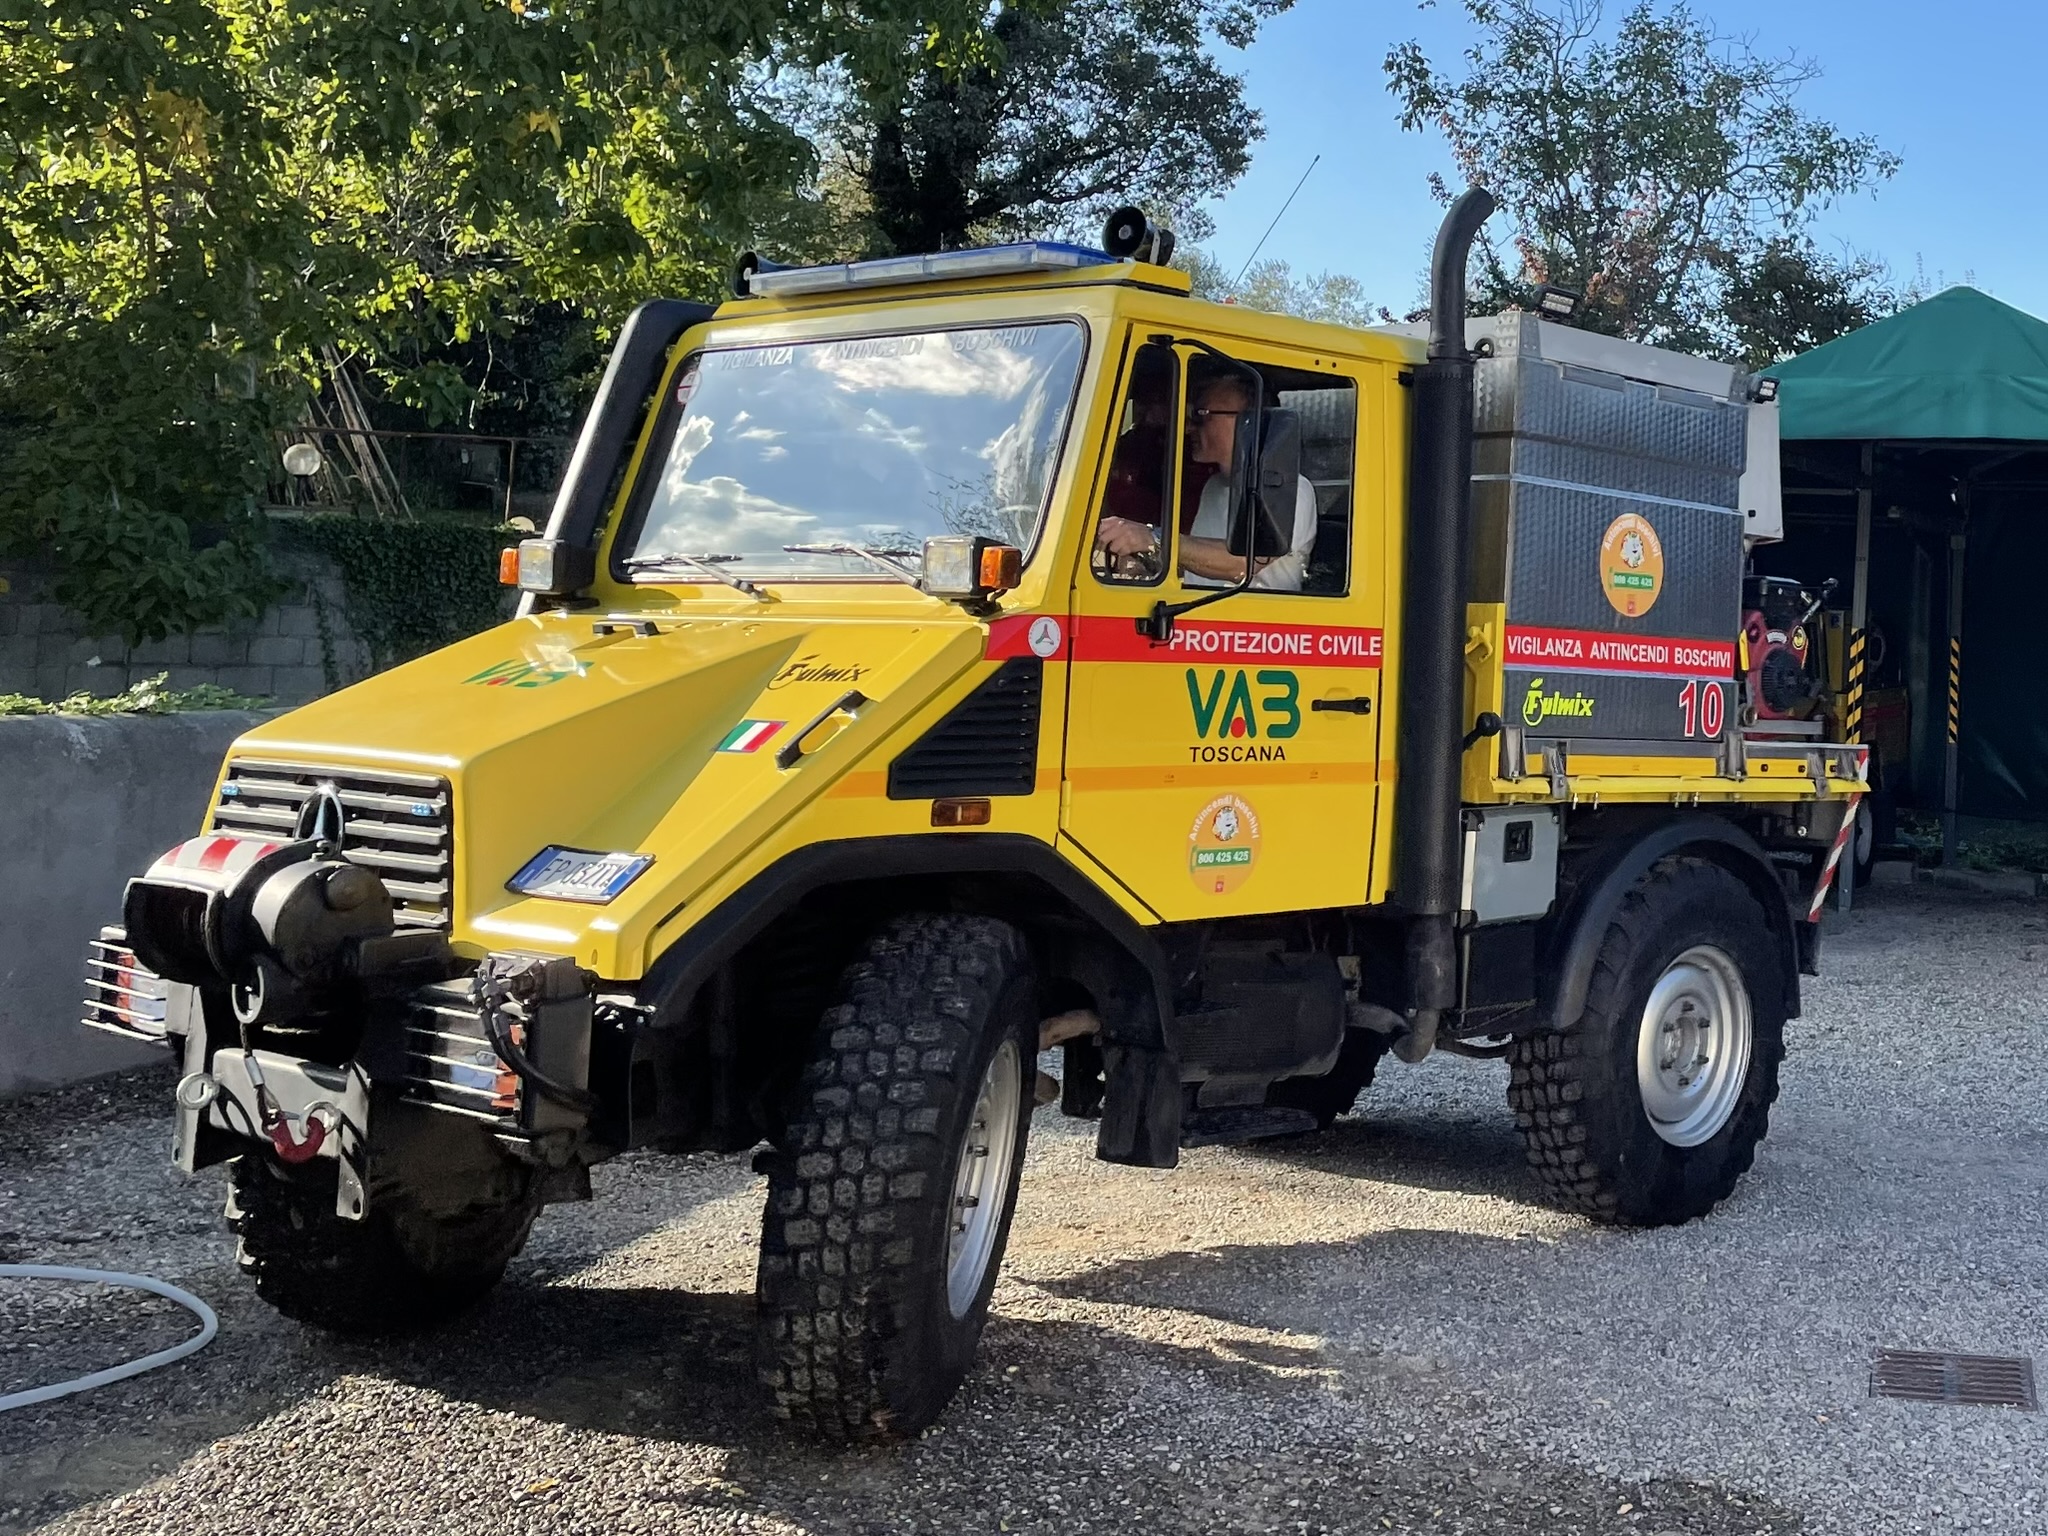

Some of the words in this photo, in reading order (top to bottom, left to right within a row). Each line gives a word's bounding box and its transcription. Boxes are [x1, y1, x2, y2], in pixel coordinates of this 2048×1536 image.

[720, 347, 793, 370] VIGILANZA
[826, 336, 925, 361] ANTINCENDI
[953, 327, 1039, 351] BOSCHIVI
[1169, 629, 1313, 654] PROTEZIONE
[1318, 634, 1382, 656] CIVILE
[1507, 635, 1583, 658] VIGILANZA
[1590, 641, 1668, 663] ANTINCENDI
[1674, 647, 1731, 668] BOSCHIVI
[1186, 668, 1301, 738] VAB
[1523, 680, 1594, 726] Fulmix
[1679, 680, 1724, 738] 10
[1190, 745, 1286, 762] TOSCANA
[1189, 795, 1233, 841] Antincendi
[1198, 852, 1214, 864] 800
[1215, 851, 1232, 863] 425
[1233, 850, 1249, 862] 425
